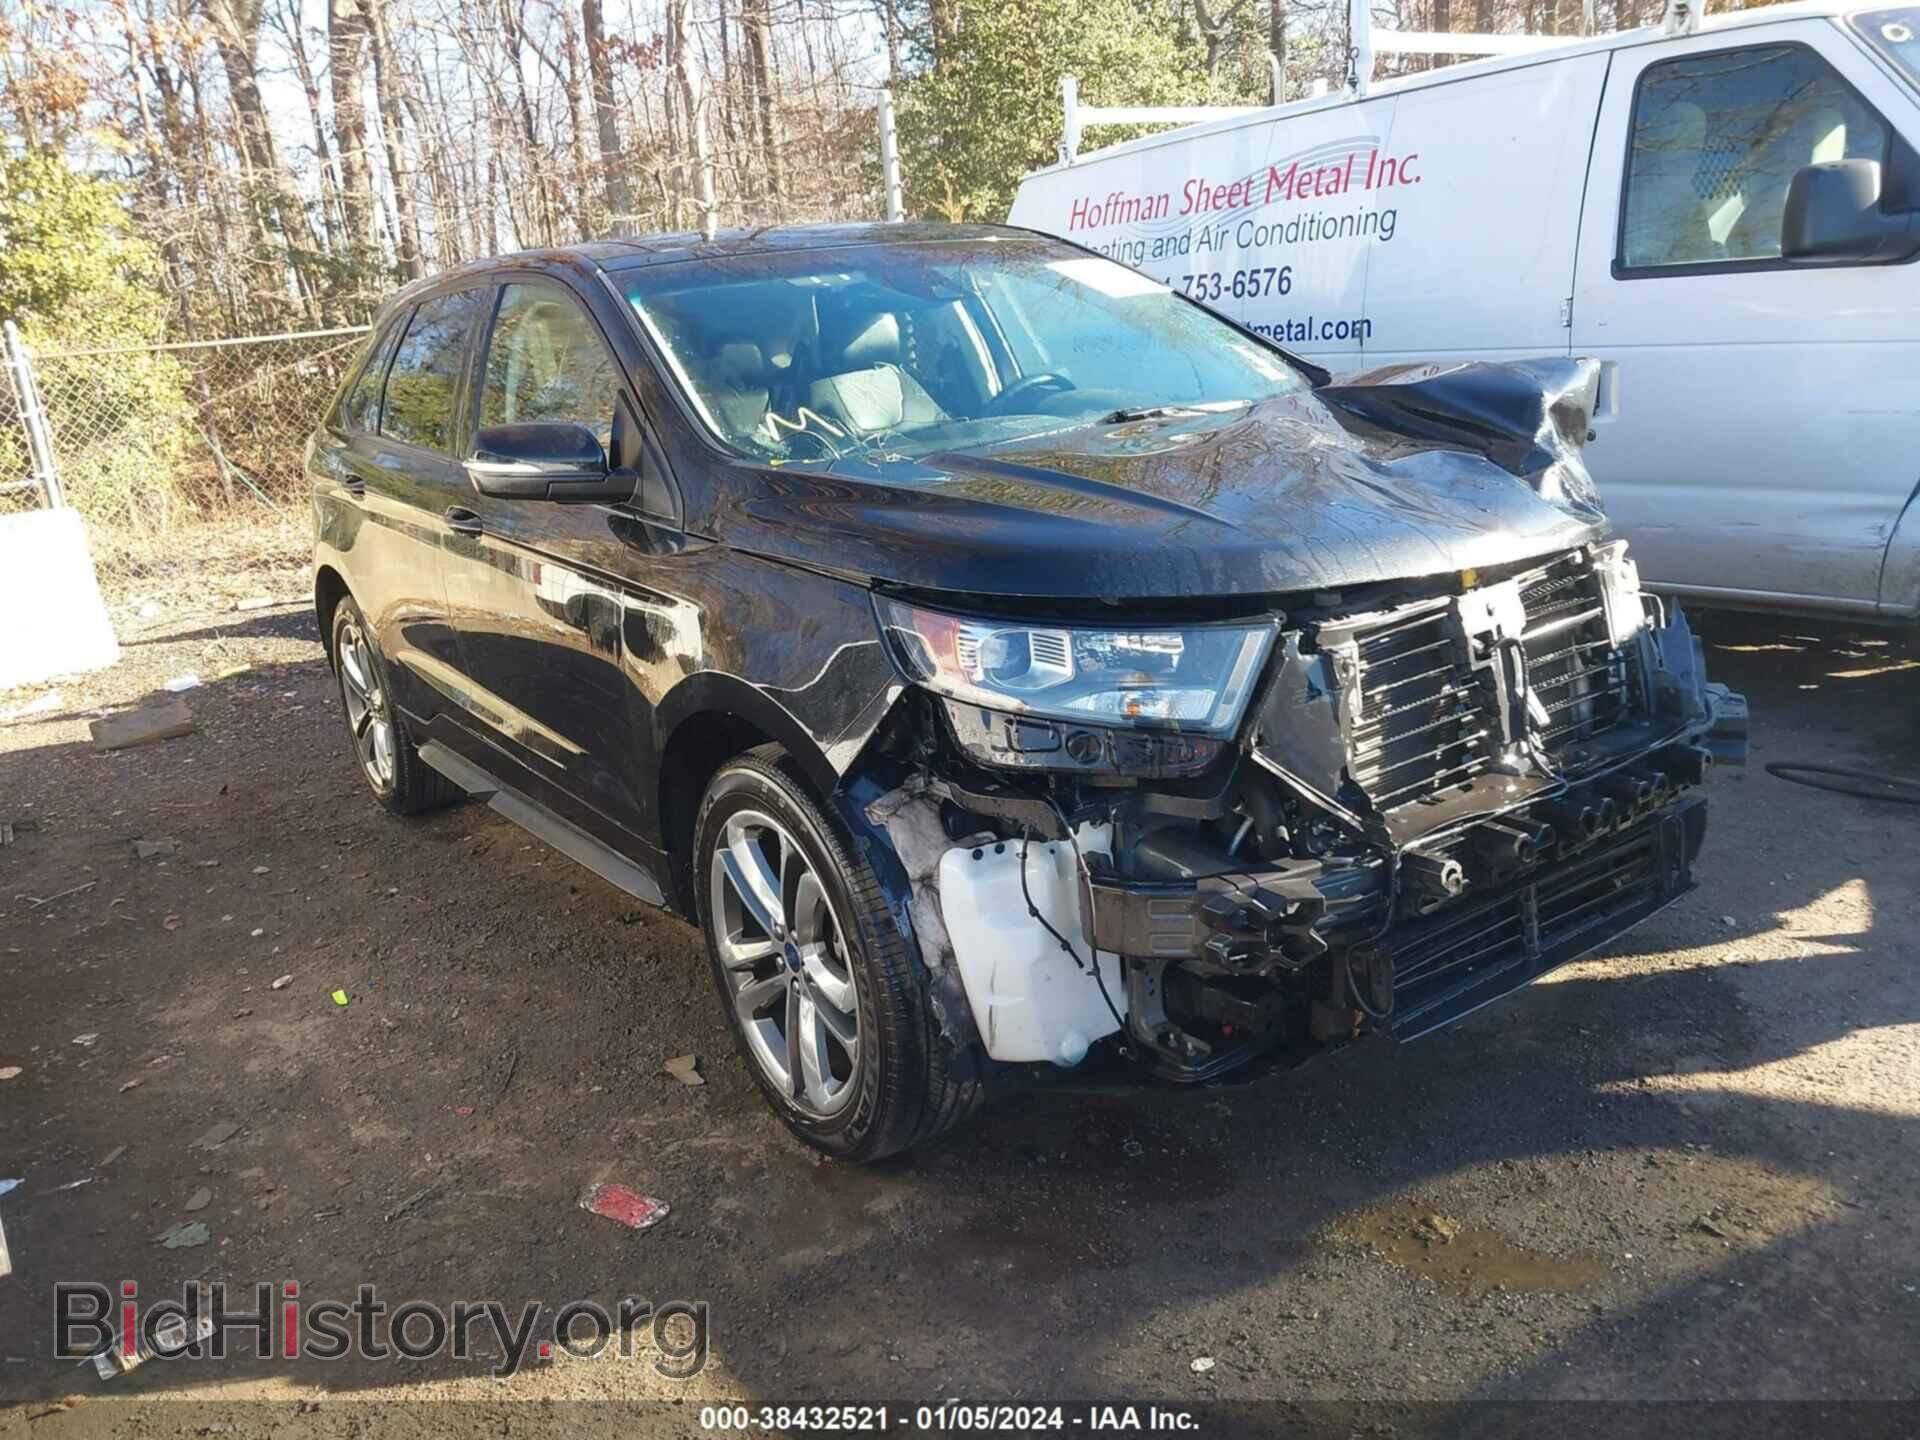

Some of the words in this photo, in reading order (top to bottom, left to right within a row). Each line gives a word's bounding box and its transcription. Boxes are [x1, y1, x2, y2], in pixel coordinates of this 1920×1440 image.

[1069, 191, 1170, 231] Hoffman
[1179, 172, 1254, 215] Sheet
[1265, 153, 1355, 204] Metal
[1364, 148, 1422, 190] Inc.
[1086, 237, 1145, 267] ating
[1152, 228, 1192, 258] and
[1196, 224, 1229, 252] Air
[1236, 206, 1398, 250] Conditioning
